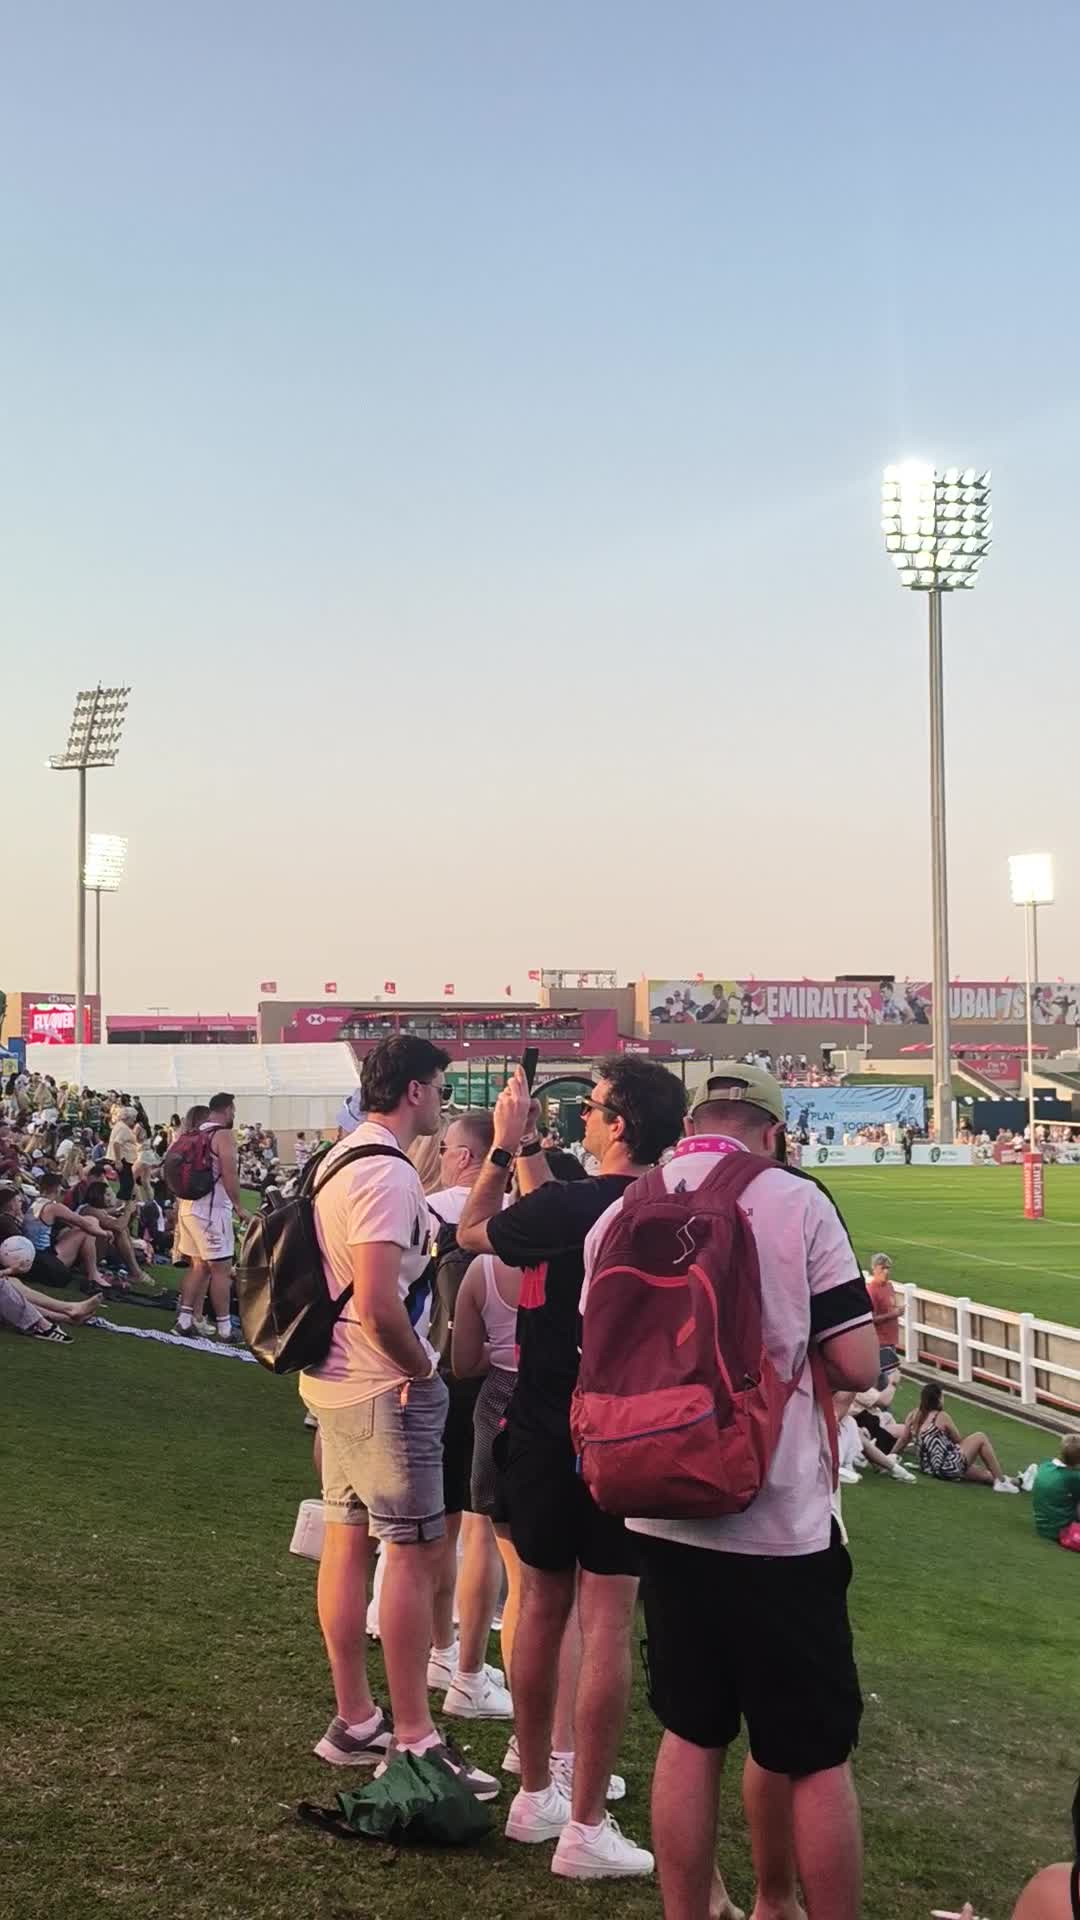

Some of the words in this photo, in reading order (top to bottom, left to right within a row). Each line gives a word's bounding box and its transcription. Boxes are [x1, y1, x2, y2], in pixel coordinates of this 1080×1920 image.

[767, 986, 872, 1018] EMIRATES
[948, 987, 996, 1019] UBAI
[811, 1111, 836, 1121] PLAY
[1033, 1162, 1043, 1210] Emirates
